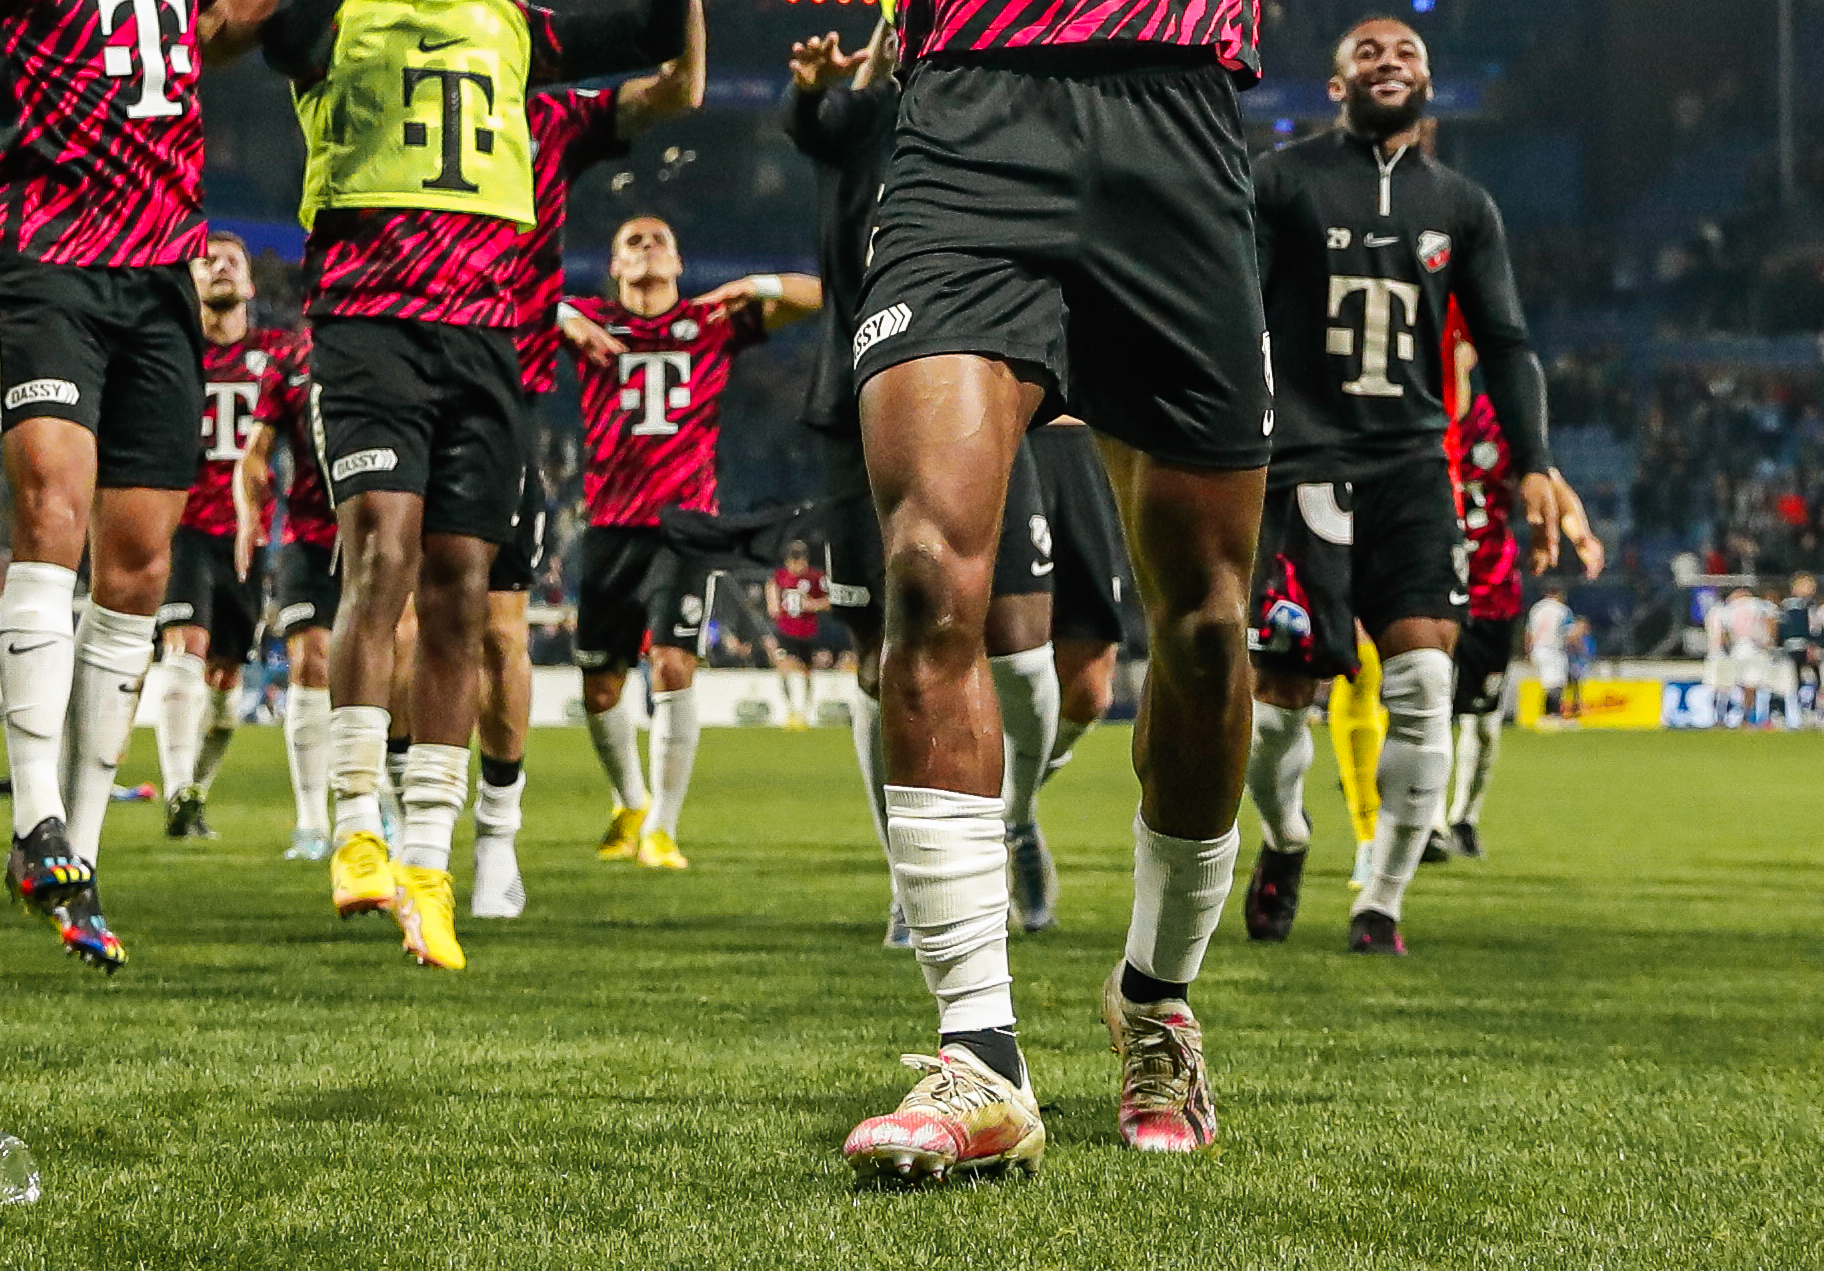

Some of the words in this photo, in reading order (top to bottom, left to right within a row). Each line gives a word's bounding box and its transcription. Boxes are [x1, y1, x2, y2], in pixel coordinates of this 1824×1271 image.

[403, 67, 494, 193] T
[1326, 275, 1420, 396] T
[11, 383, 61, 405] DASSY
[201, 382, 259, 460] T
[619, 351, 691, 435] T
